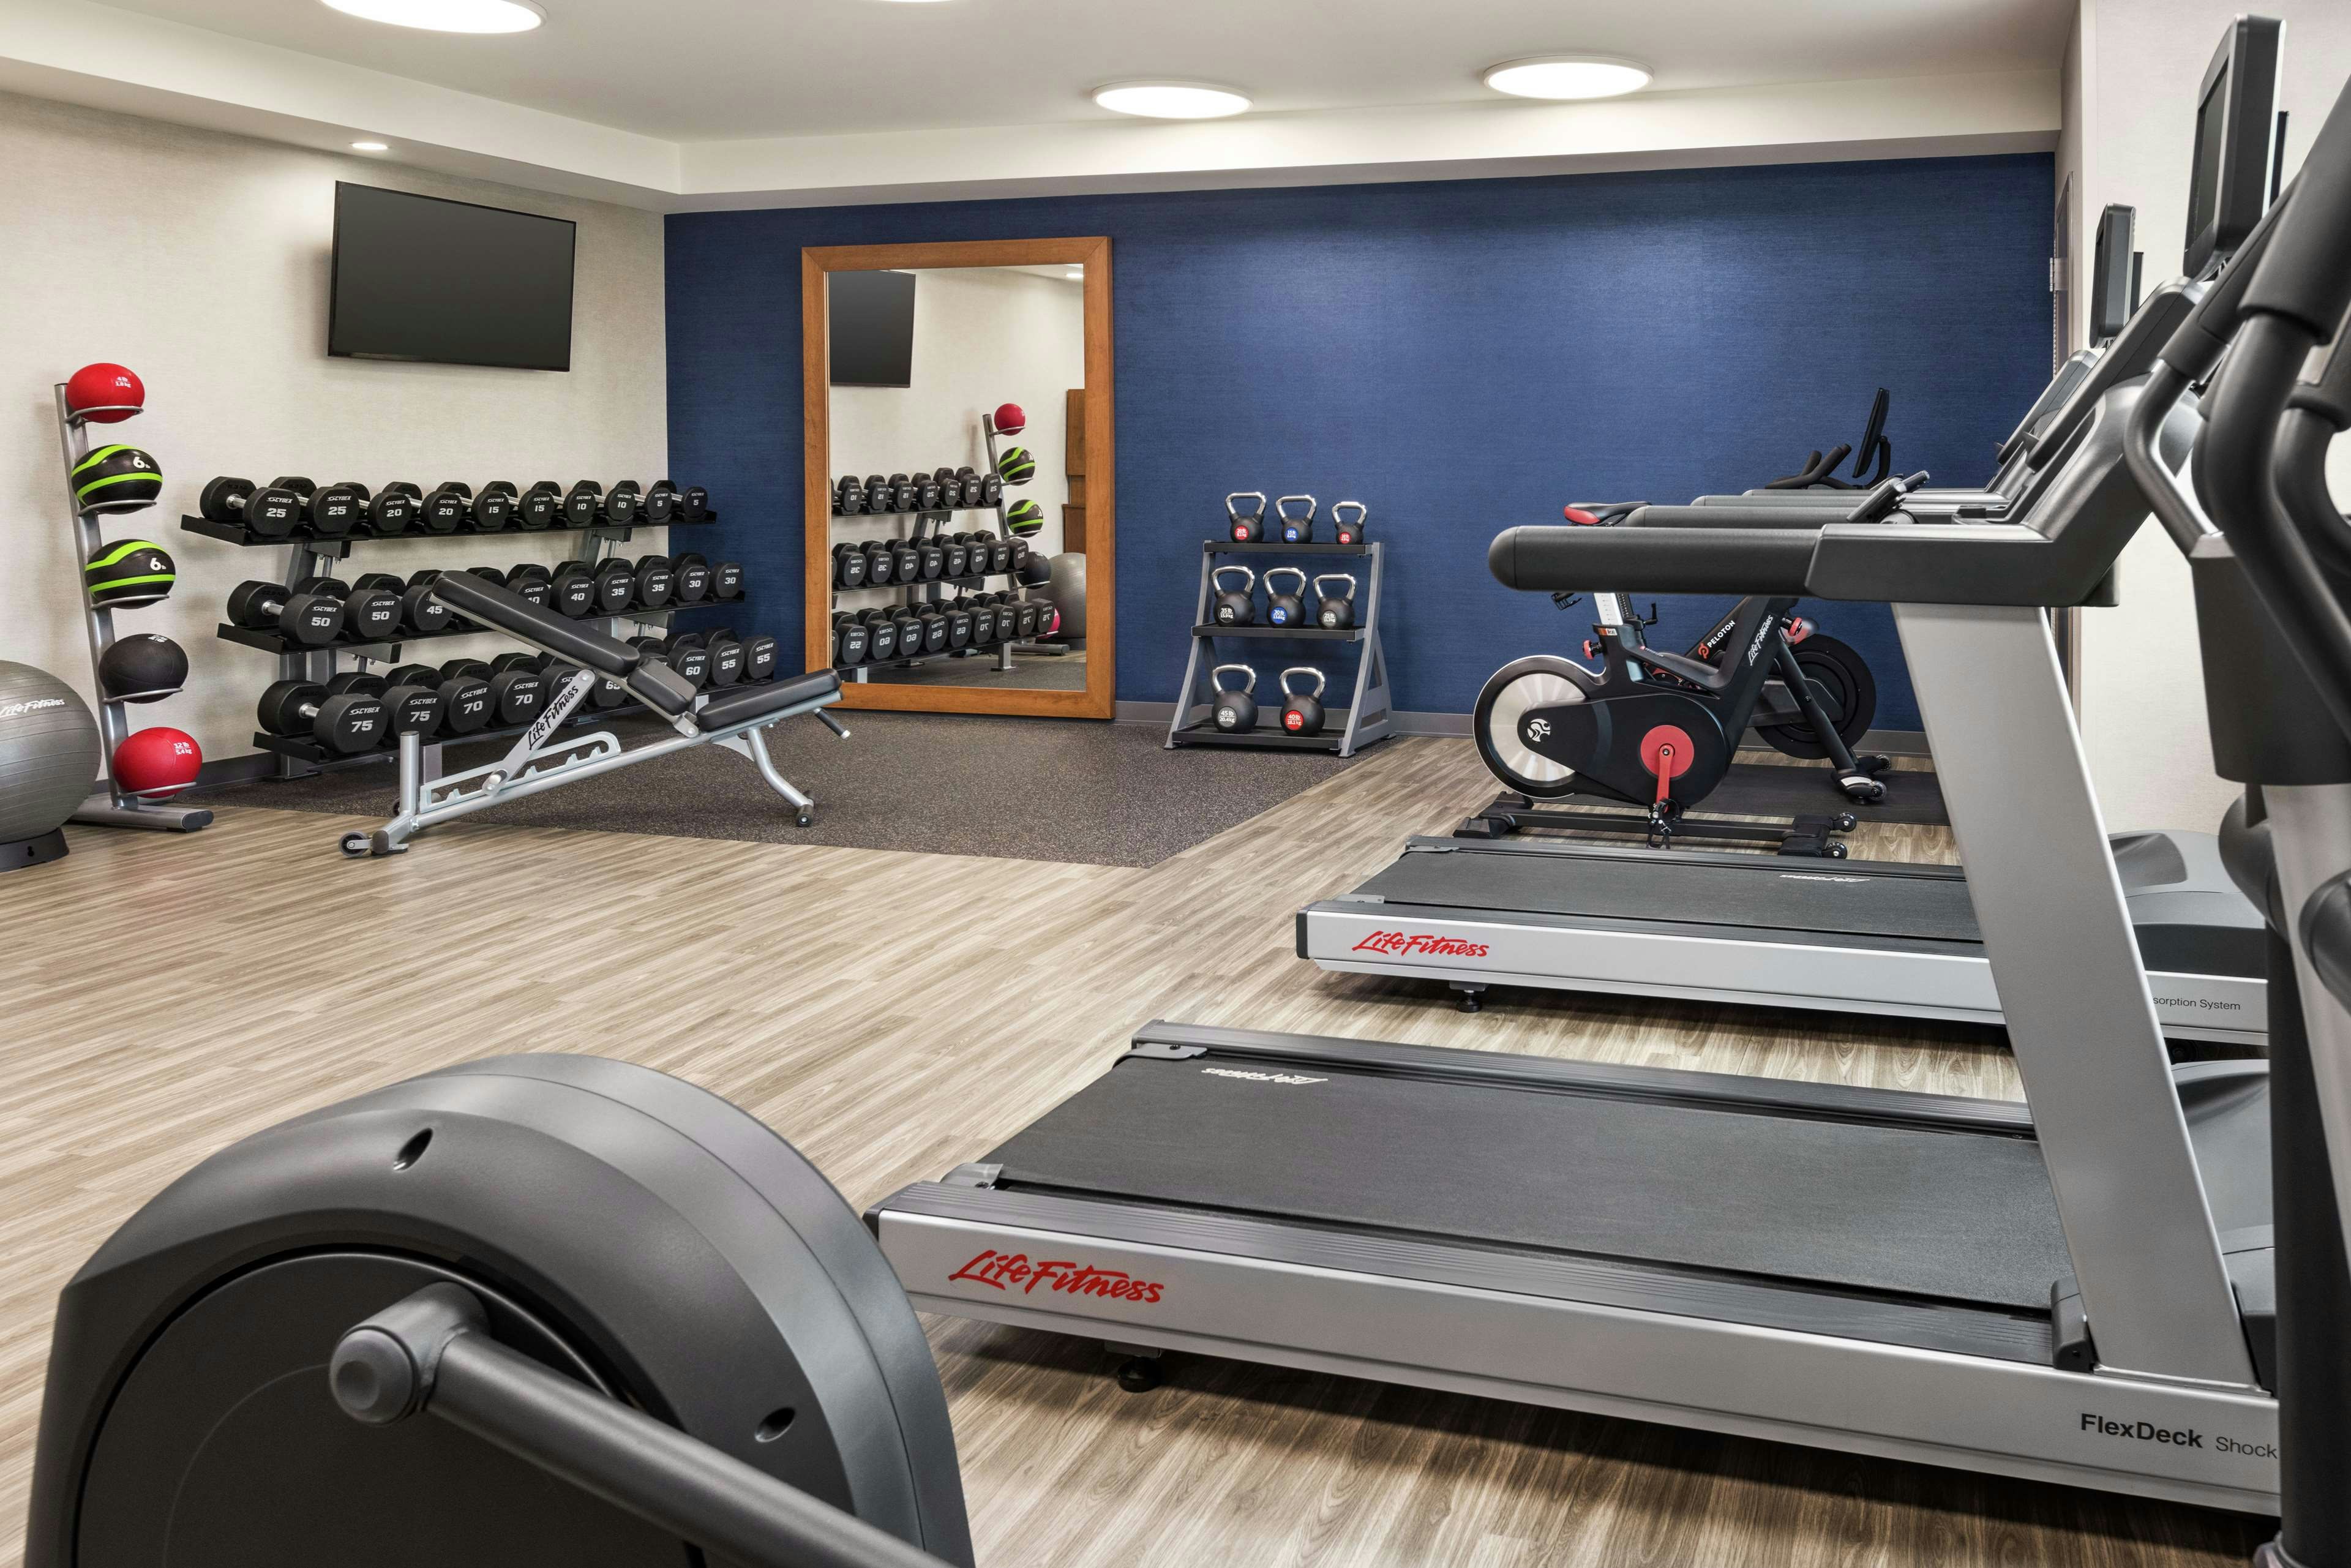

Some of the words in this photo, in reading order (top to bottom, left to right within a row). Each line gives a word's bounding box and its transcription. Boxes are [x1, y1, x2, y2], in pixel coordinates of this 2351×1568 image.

[266, 508, 286, 517] 25
[328, 506, 347, 515] 25
[427, 606, 443, 614] 45
[372, 612, 389, 620] 50
[312, 617, 330, 626] 50
[1707, 620, 1736, 648] PELOTON
[757, 653, 770, 664] 55
[722, 659, 735, 669] 55
[686, 666, 700, 675] 60
[468, 687, 488, 697] CYBEX
[516, 694, 533, 705] 70
[464, 701, 482, 714] 70
[411, 711, 430, 722] 75
[352, 720, 373, 732] 75
[2153, 997, 2197, 1007] sorption
[2199, 999, 2241, 1010] System
[2081, 1412, 2204, 1449] FlexDeck
[2215, 1436, 2279, 1460] Shock
